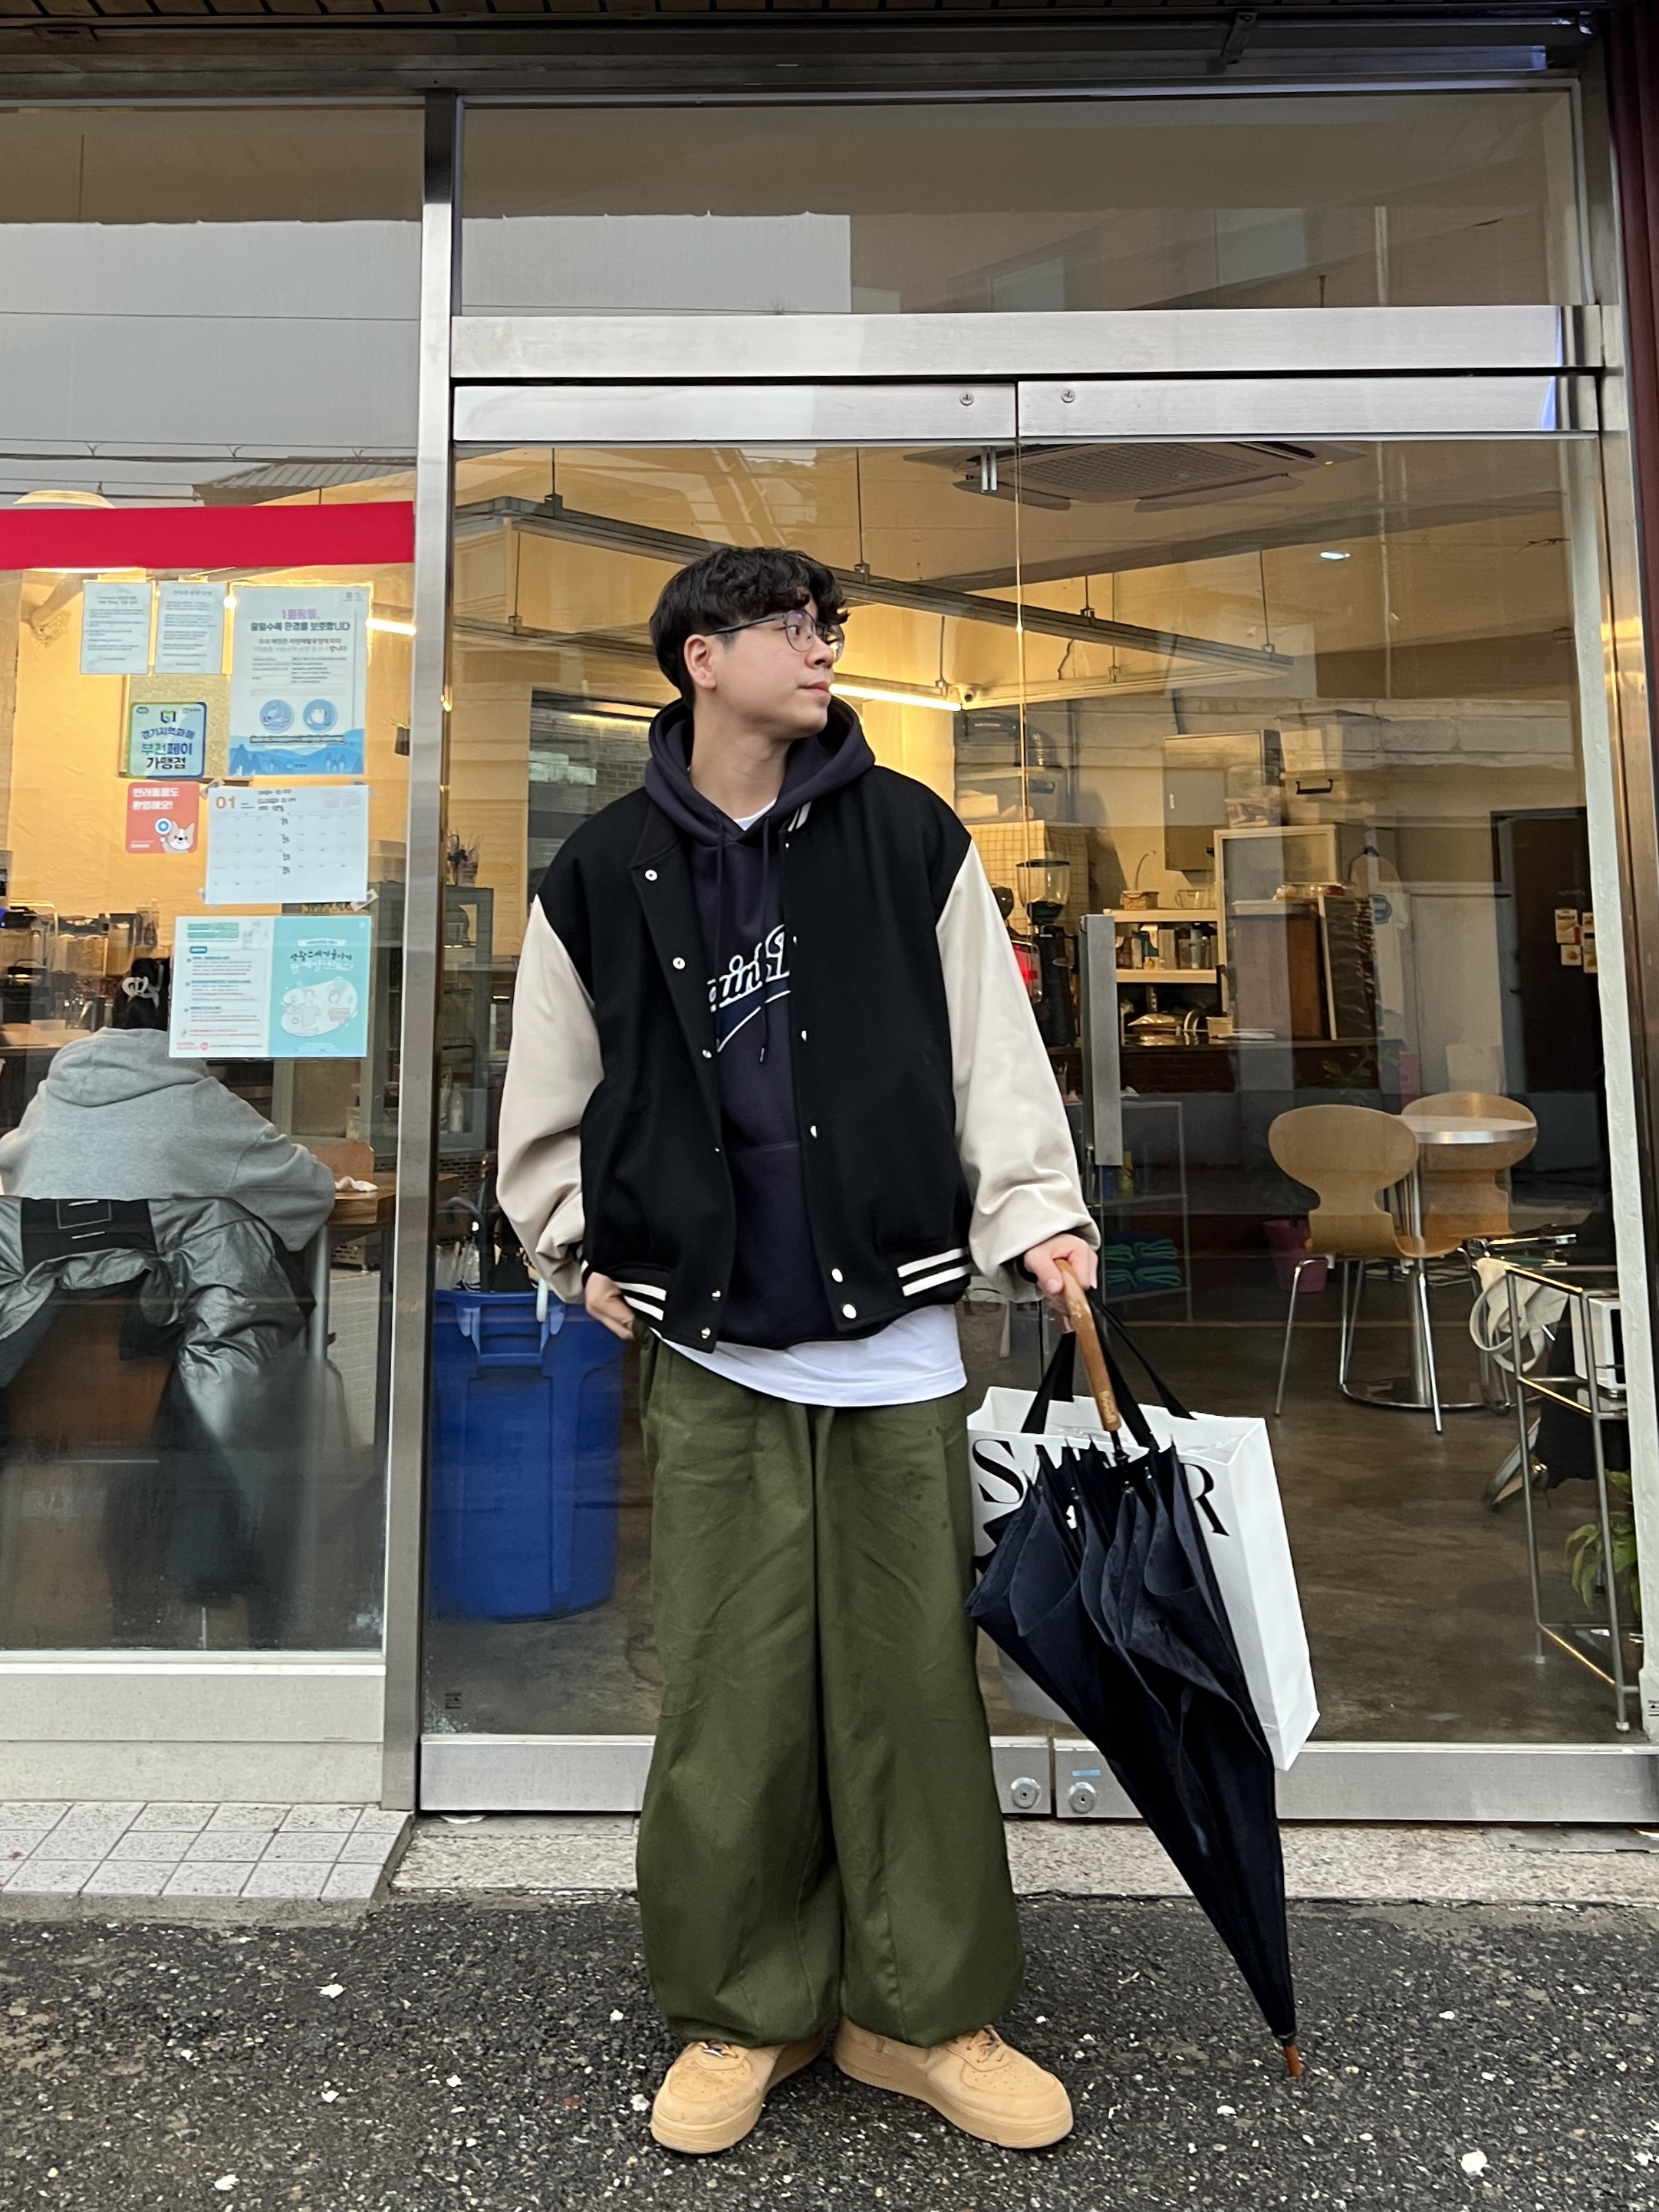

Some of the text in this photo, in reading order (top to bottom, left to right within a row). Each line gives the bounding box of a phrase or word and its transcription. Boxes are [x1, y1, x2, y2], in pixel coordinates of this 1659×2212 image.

[141, 742, 193, 755] 부천페이
[146, 756, 186, 770] 가맹점
[215, 795, 235, 809] 01
